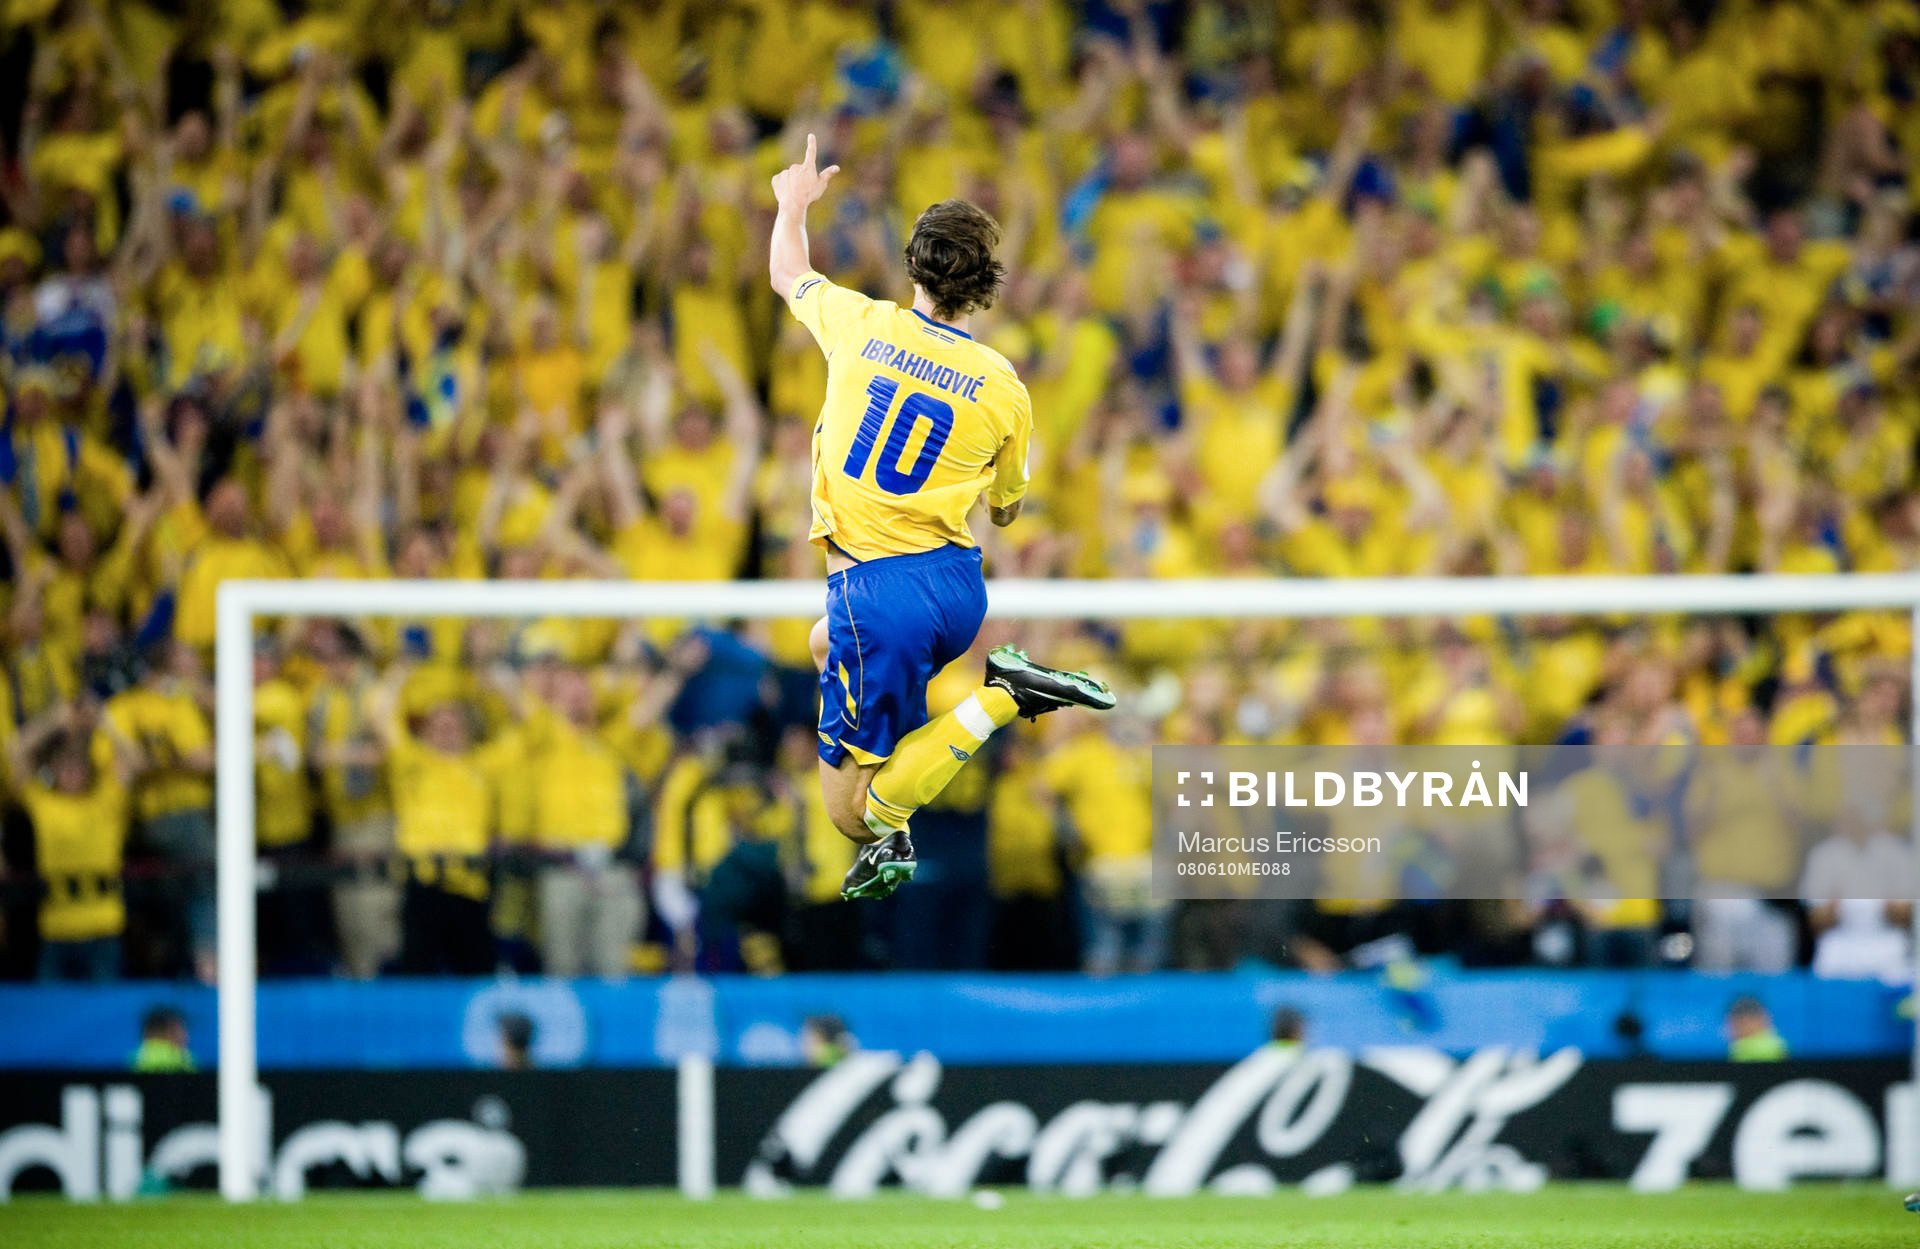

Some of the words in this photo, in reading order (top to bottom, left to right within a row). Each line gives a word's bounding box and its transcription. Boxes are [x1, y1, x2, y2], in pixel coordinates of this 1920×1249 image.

[861, 338, 986, 403] IBRAHIMOVIĆ
[843, 375, 954, 495] 10
[742, 1045, 1585, 1198] Coca-Cla
